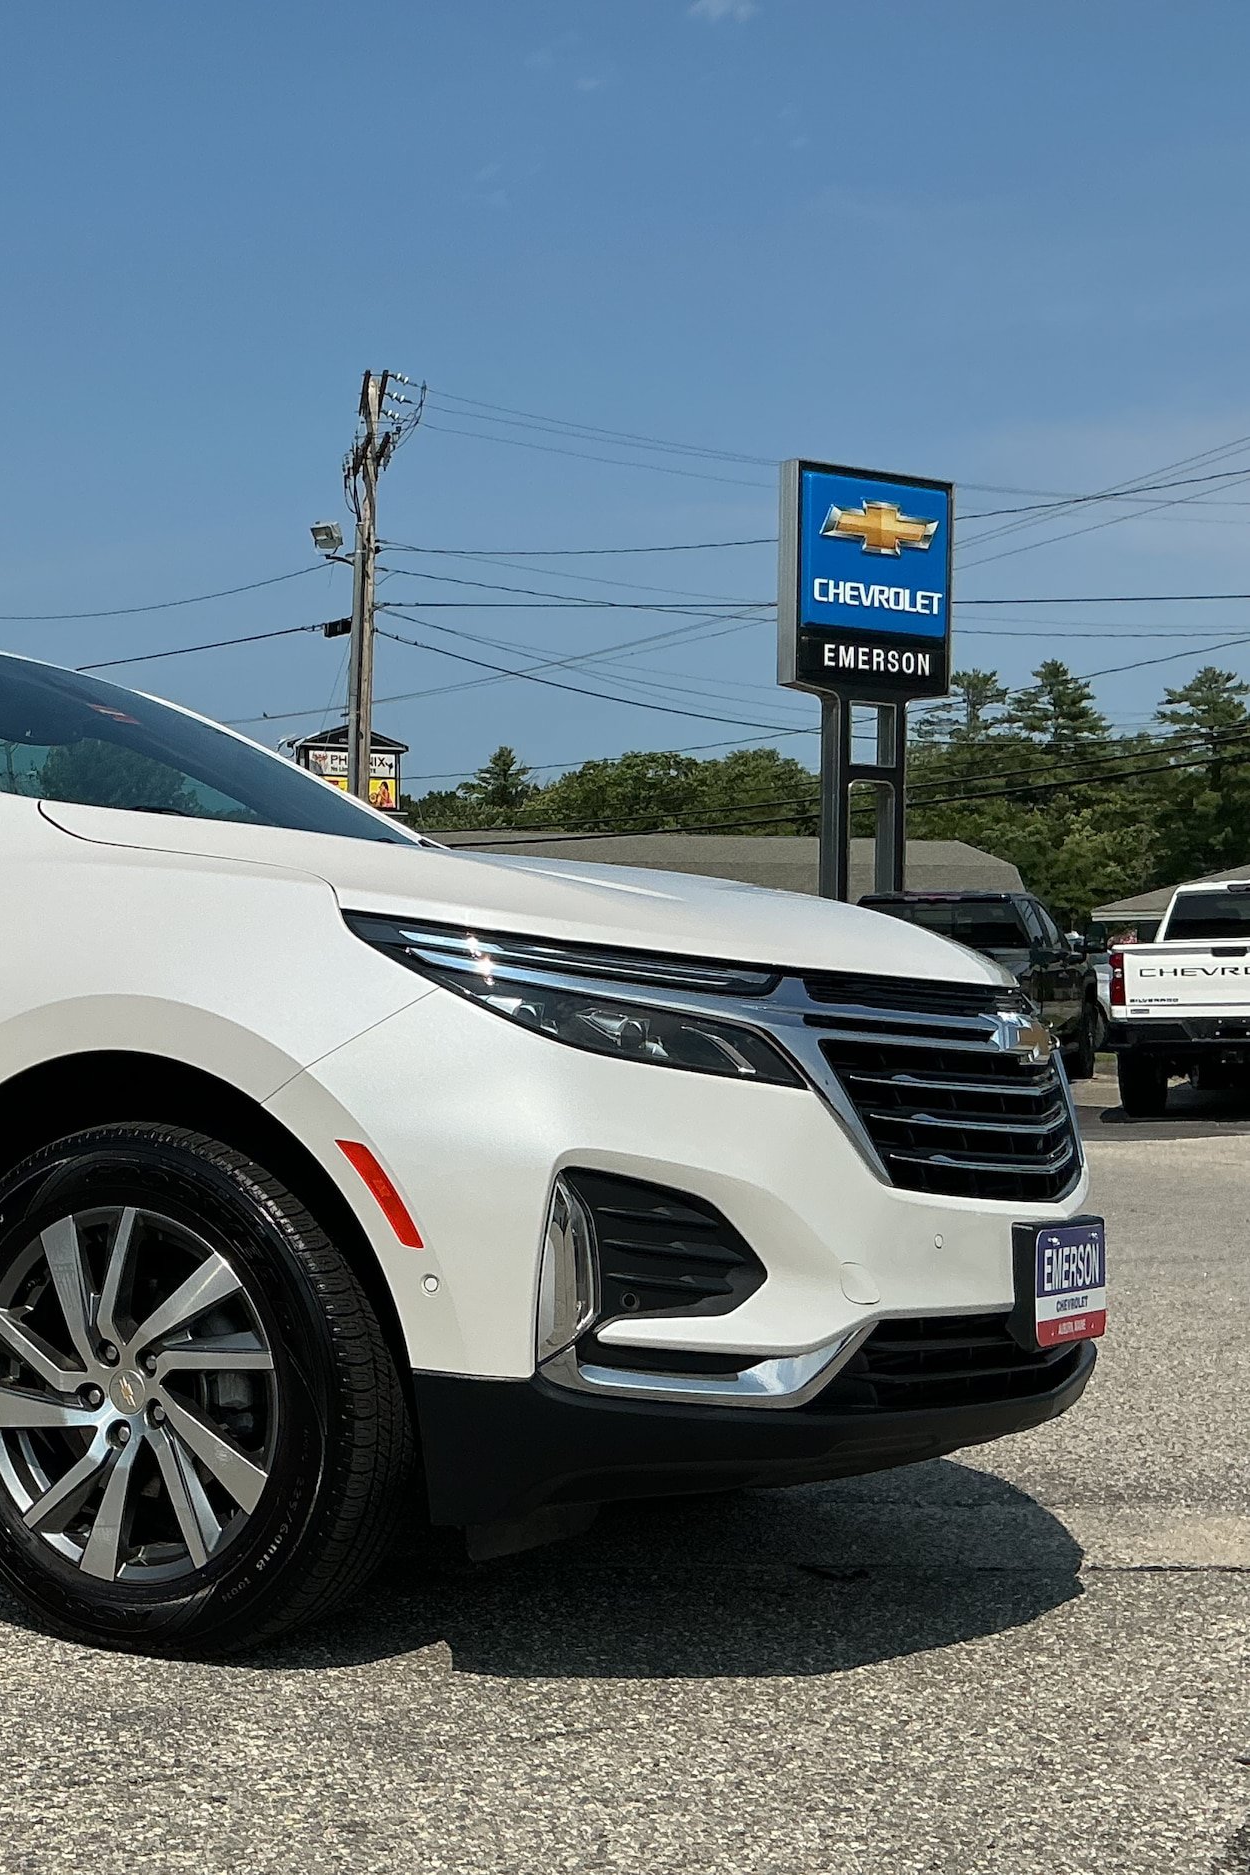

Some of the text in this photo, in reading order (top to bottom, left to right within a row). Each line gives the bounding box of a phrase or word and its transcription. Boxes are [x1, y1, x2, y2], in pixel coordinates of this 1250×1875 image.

[813, 578, 942, 614] CHEVROLET
[823, 643, 930, 676] EMERSON
[330, 754, 385, 767] PHIX
[1043, 1243, 1100, 1291] EMERSON
[1056, 1295, 1088, 1312] CHEVROLET
